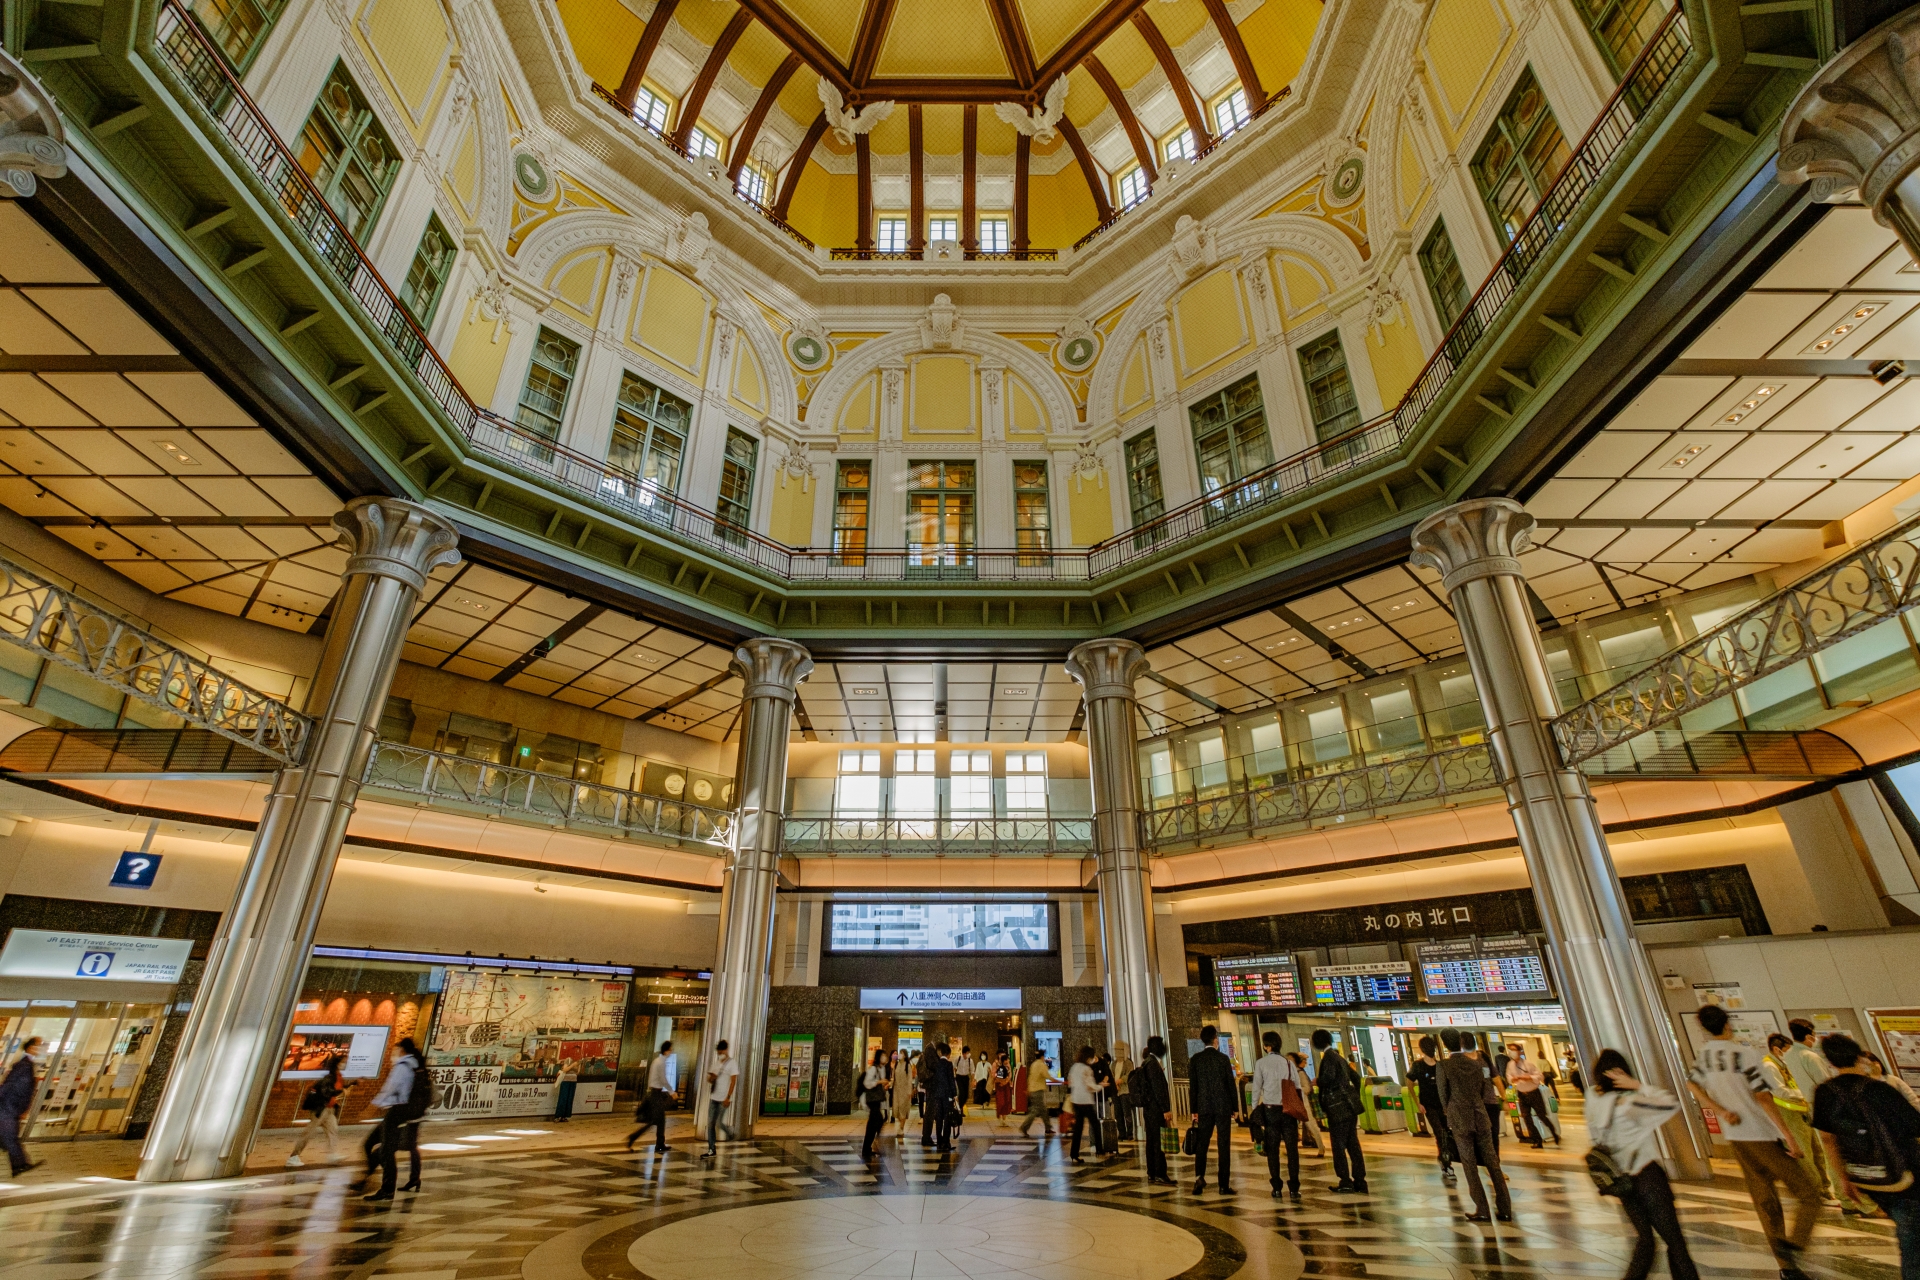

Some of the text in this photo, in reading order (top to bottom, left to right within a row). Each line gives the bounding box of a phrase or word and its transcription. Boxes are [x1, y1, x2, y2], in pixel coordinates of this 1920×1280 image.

[1363, 906, 1471, 931] 丸の内北口
[910, 992, 986, 1000] 八重洲側への自由通路
[1379, 1033, 1385, 1042] 2
[498, 1088, 513, 1098] 10.8
[529, 1088, 538, 1097] 1.9
